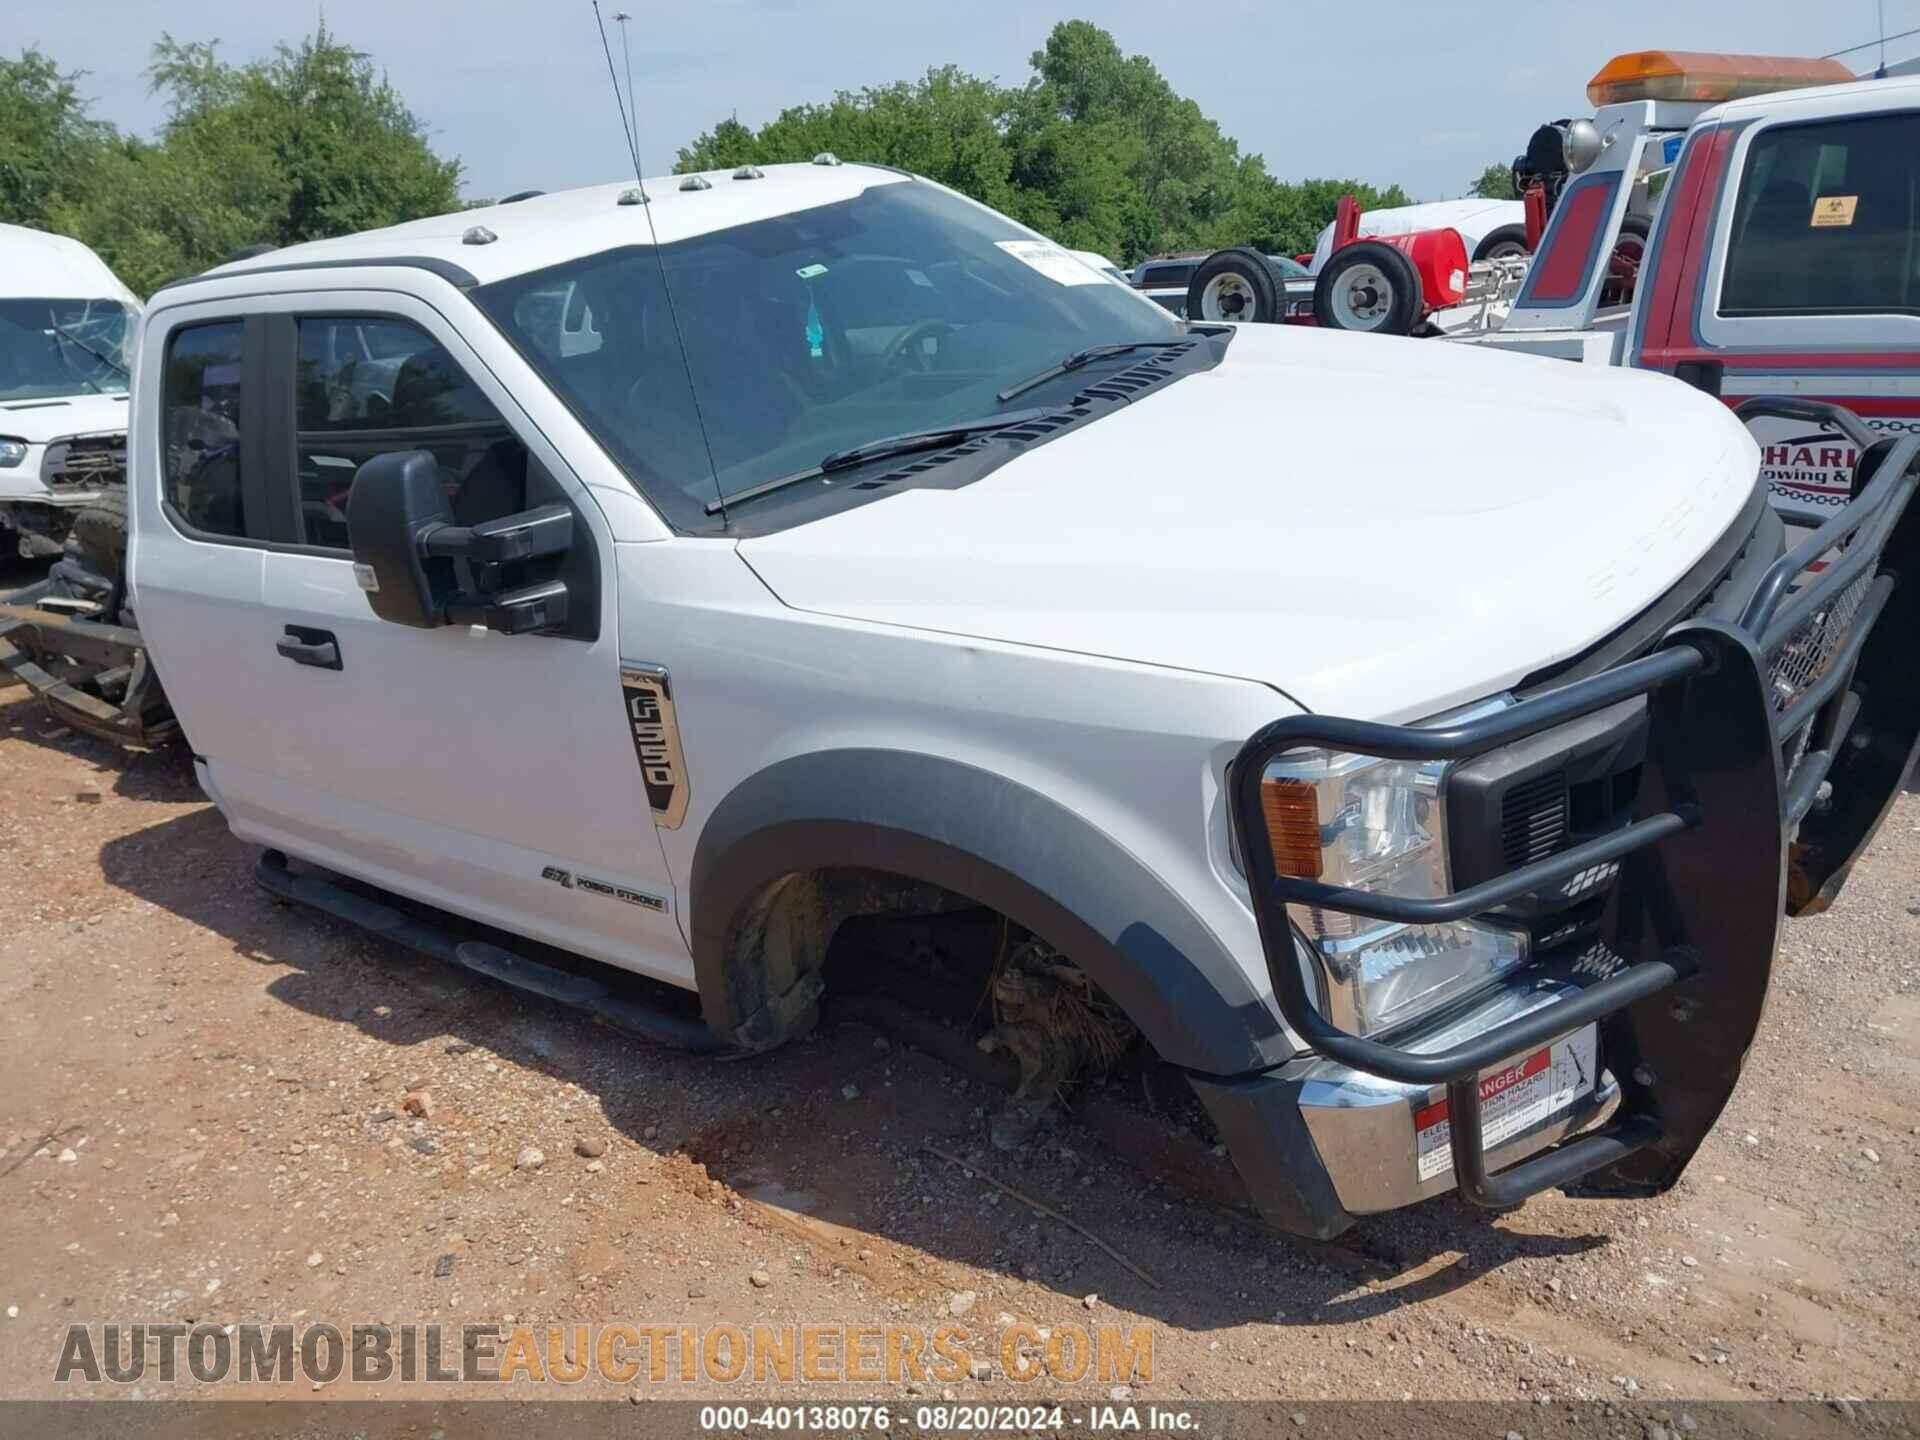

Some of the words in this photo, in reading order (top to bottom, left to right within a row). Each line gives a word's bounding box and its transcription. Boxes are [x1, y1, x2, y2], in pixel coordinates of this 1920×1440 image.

[1763, 468, 1828, 485] owing
[1833, 470, 1849, 483] &
[616, 888, 664, 909] STROKE
[1478, 1059, 1530, 1098] ANGER
[1507, 1071, 1546, 1096] HAZARD
